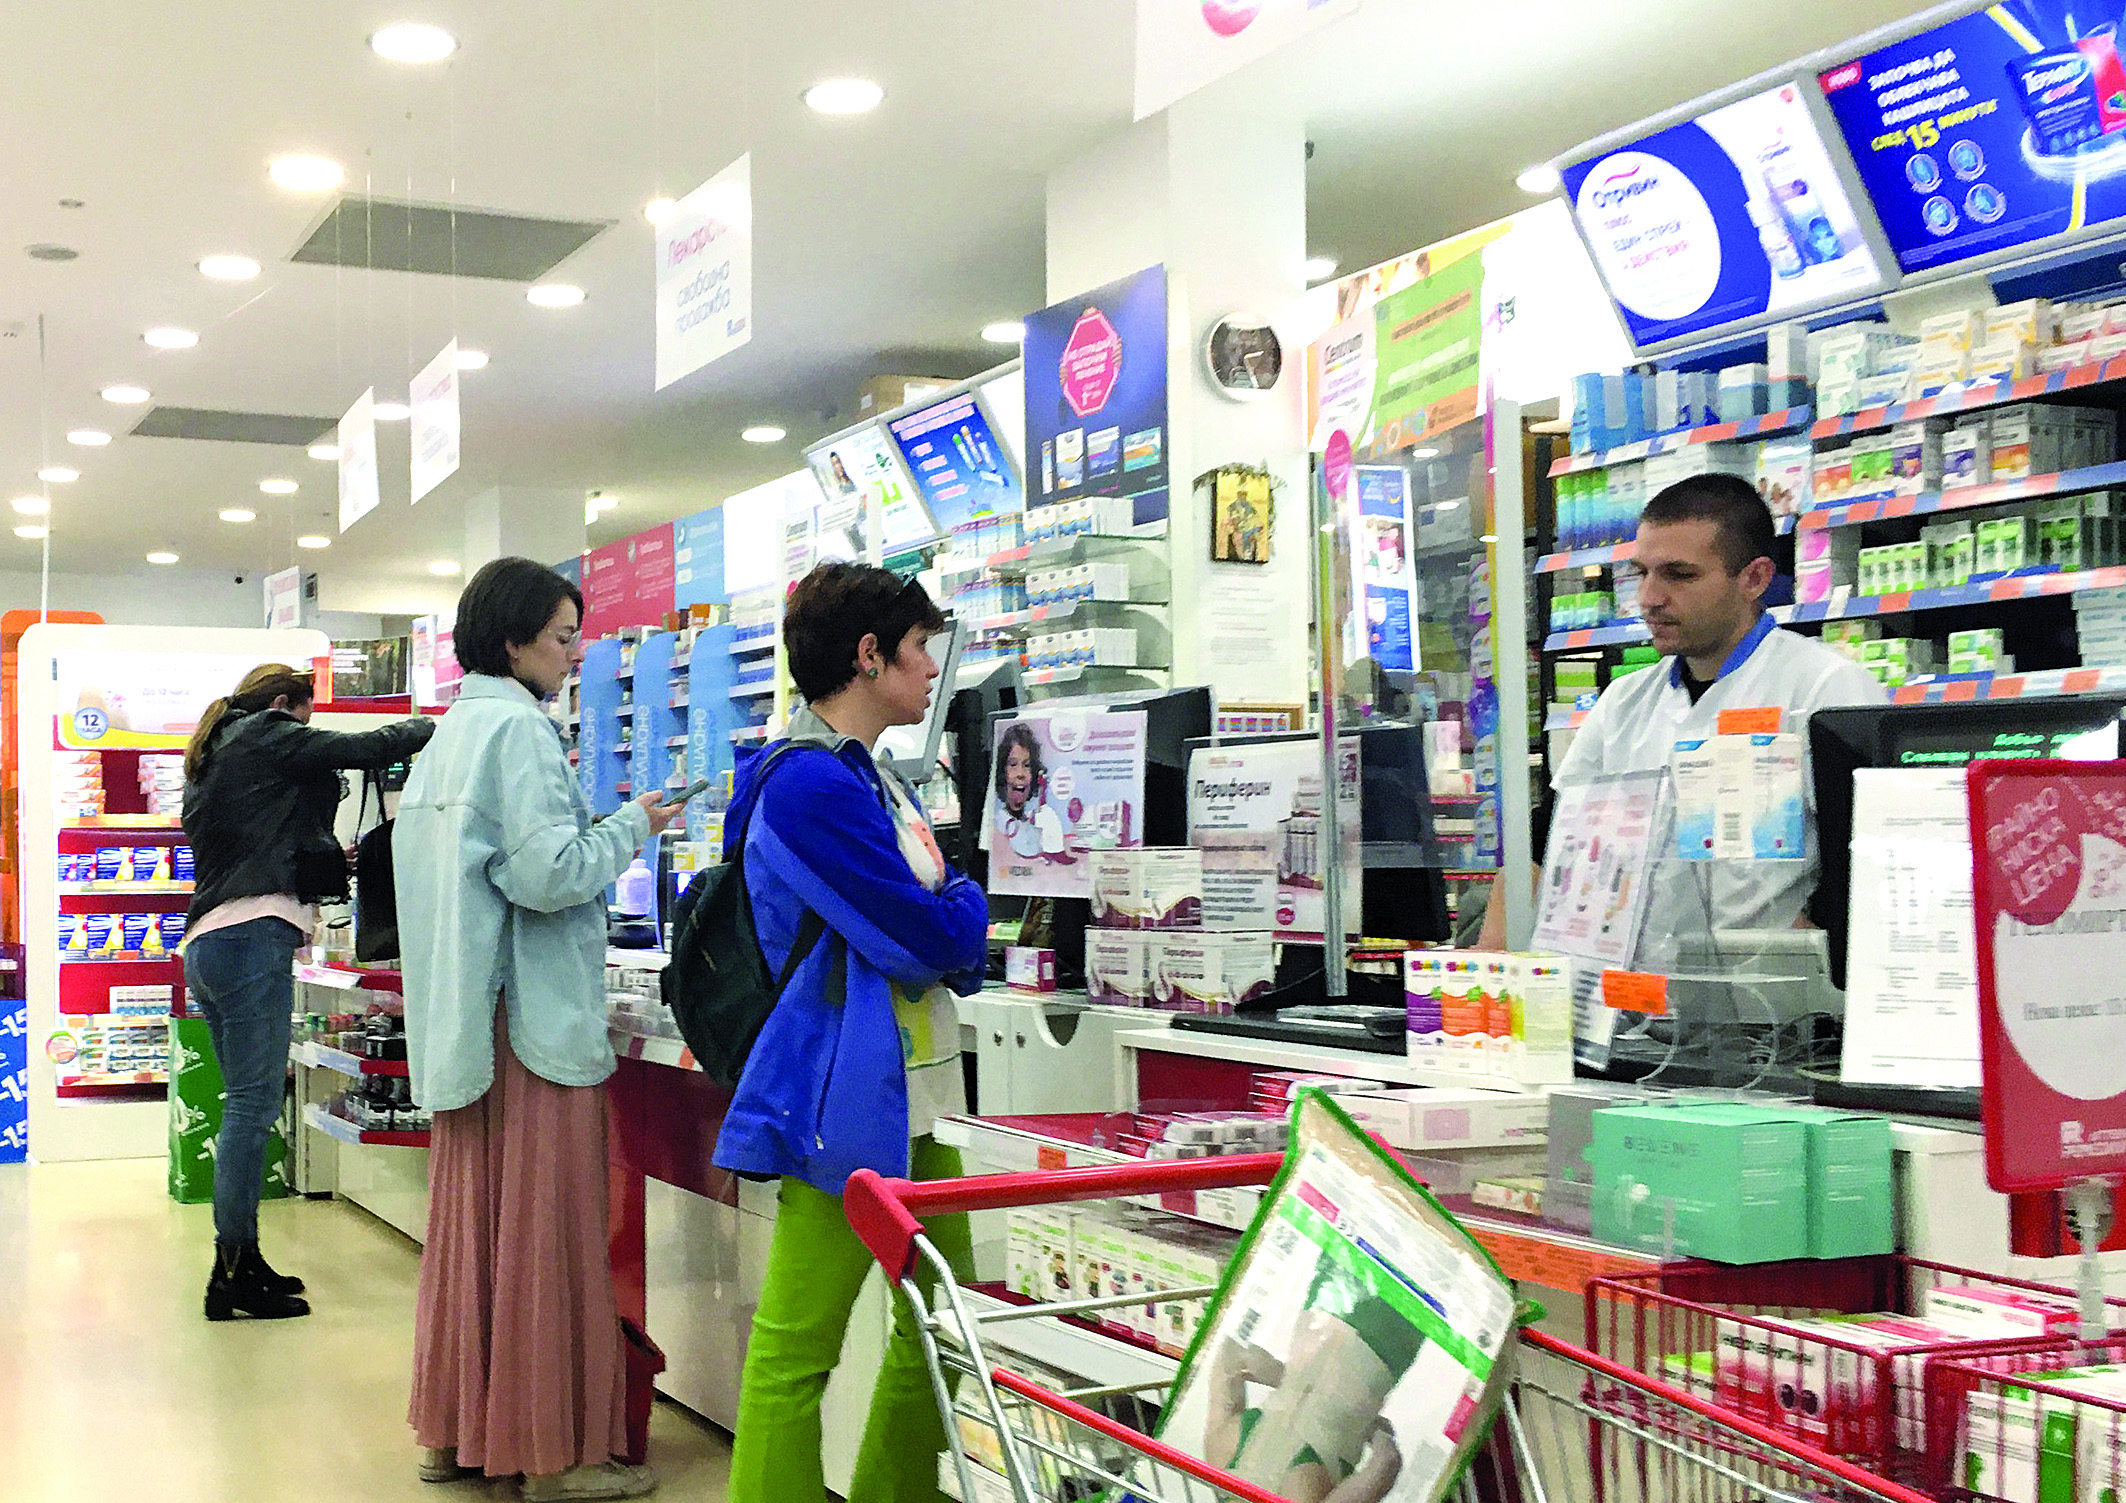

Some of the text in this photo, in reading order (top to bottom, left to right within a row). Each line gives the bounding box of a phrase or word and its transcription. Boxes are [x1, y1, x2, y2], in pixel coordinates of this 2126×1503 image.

[1906, 118, 1941, 150] 15
[82, 714, 100, 727] 12
[1195, 777, 1272, 803] Периферин
[2010, 844, 2080, 906] ЦЕНА
